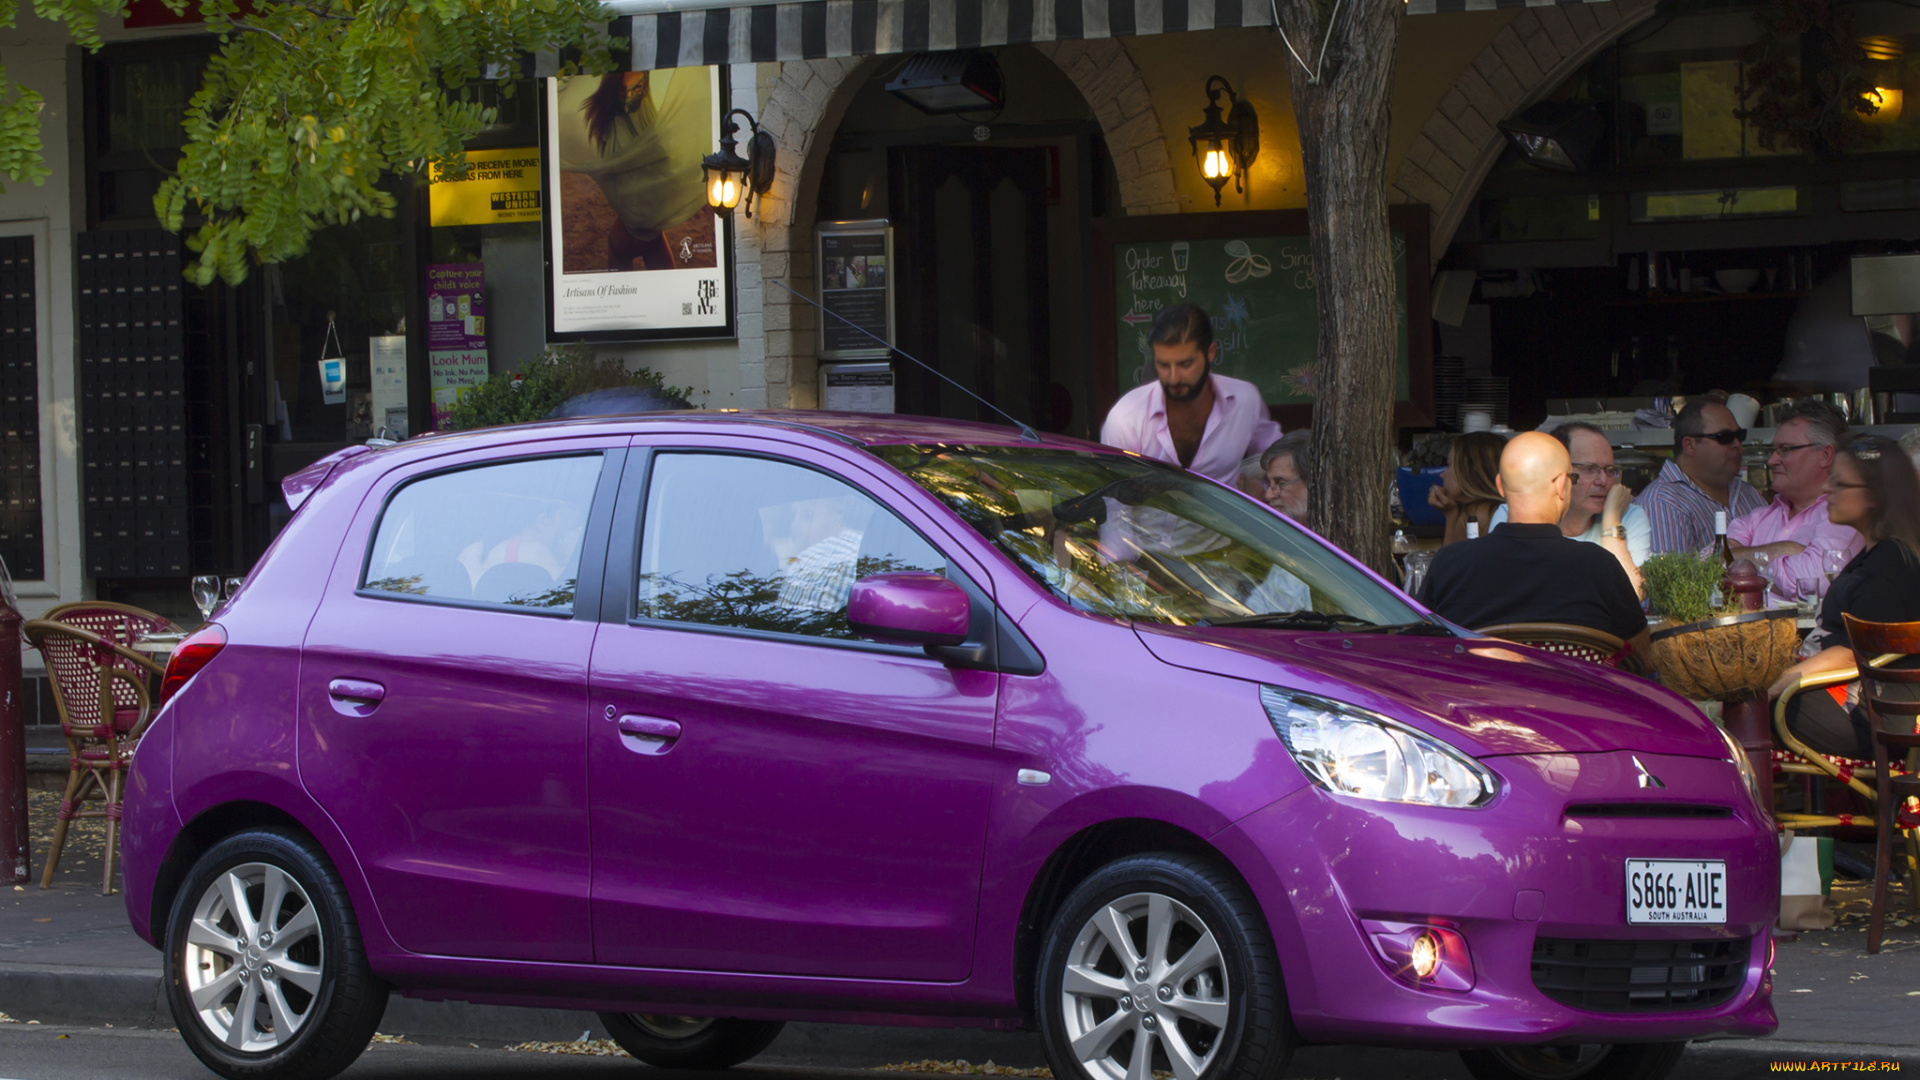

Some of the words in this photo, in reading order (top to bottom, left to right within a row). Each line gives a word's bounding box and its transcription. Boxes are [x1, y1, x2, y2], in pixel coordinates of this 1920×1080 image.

[478, 160, 510, 170] RECEIVE
[478, 171, 501, 180] FROM
[503, 169, 524, 178] HERE
[491, 191, 536, 202] WESTERN
[505, 199, 536, 209] UNION
[1125, 247, 1164, 270] Order
[429, 269, 463, 280] Capture
[465, 269, 483, 280] your
[459, 280, 480, 289] voice
[1126, 270, 1187, 298] Takeaway
[562, 287, 596, 298] Artisans
[597, 285, 608, 299] Of
[608, 284, 638, 296] Fashion
[1133, 293, 1164, 313] here
[432, 354, 459, 366] Look
[462, 353, 486, 365] Mum
[1648, 911, 1670, 920] SOUTH
[1672, 911, 1708, 920] AUSTRALIA
